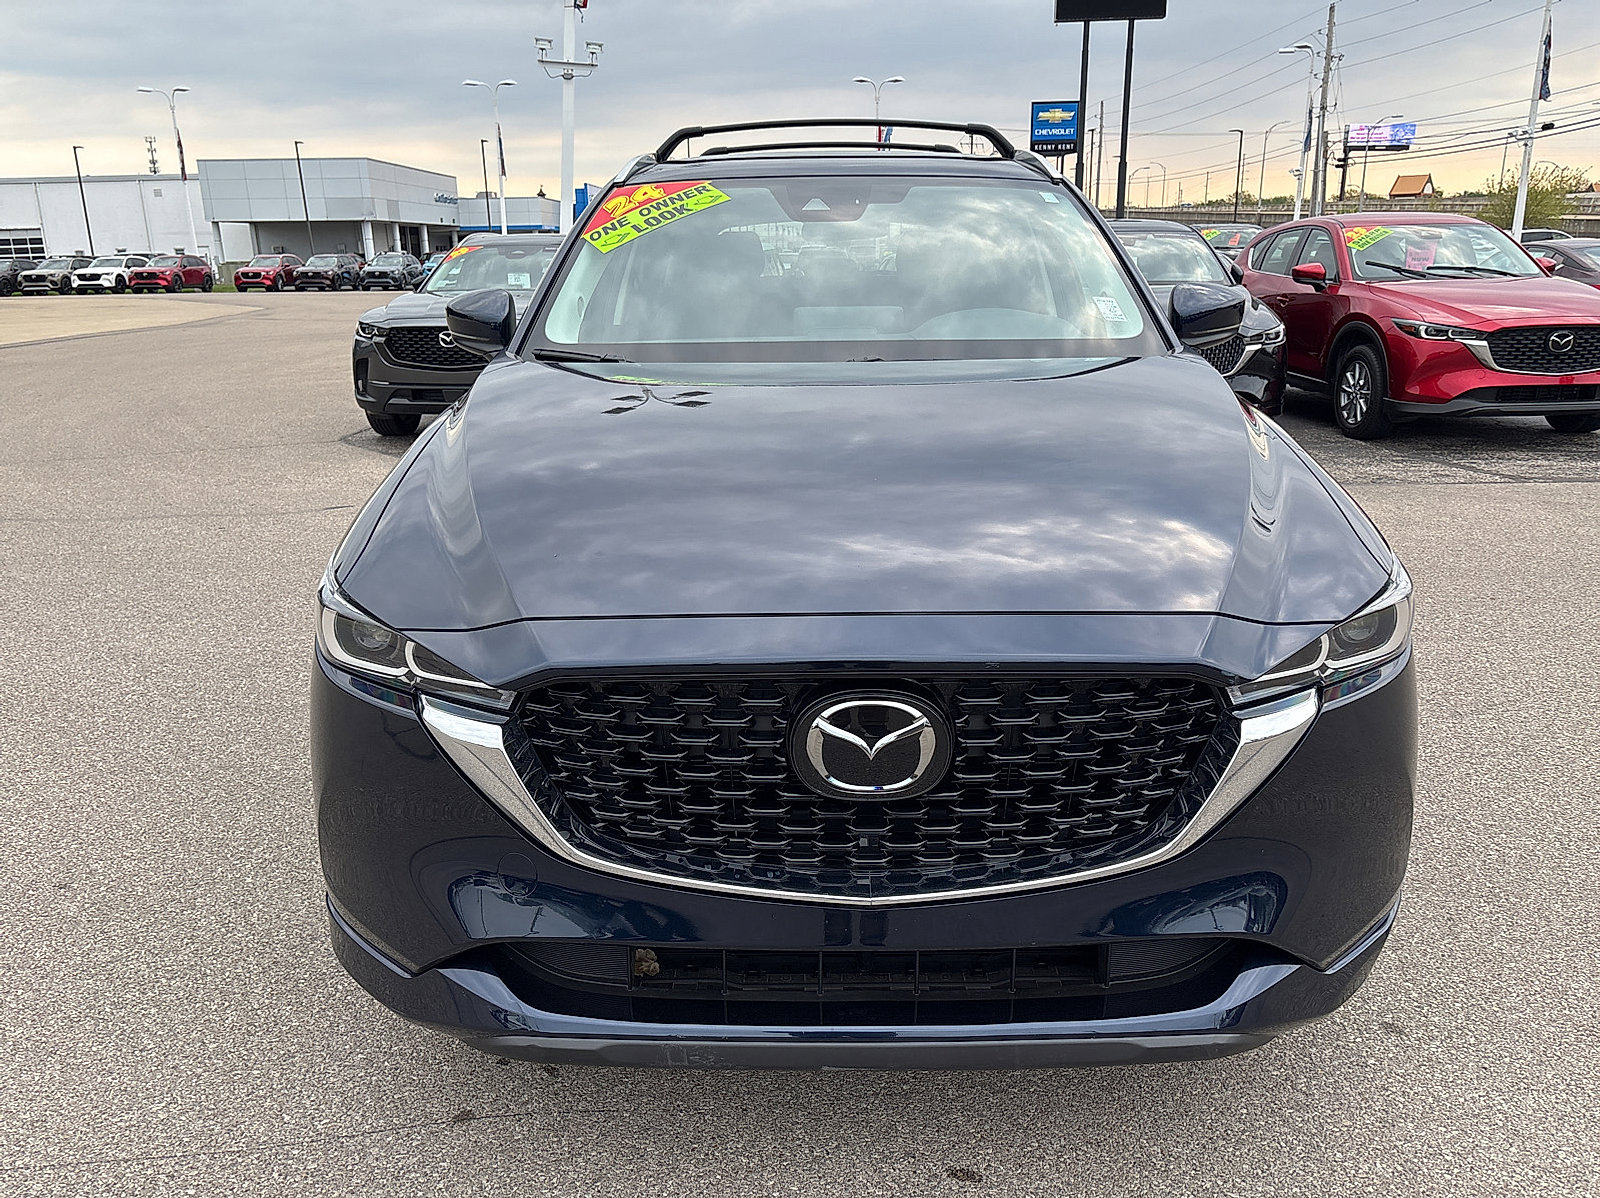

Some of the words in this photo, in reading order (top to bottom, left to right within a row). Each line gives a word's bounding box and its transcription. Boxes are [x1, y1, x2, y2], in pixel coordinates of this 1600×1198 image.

[1034, 128, 1075, 136] CHEVROLET
[589, 216, 631, 242] ONE
[638, 185, 713, 217] OWNER
[602, 184, 667, 219] 24
[630, 203, 694, 234] LOOK
